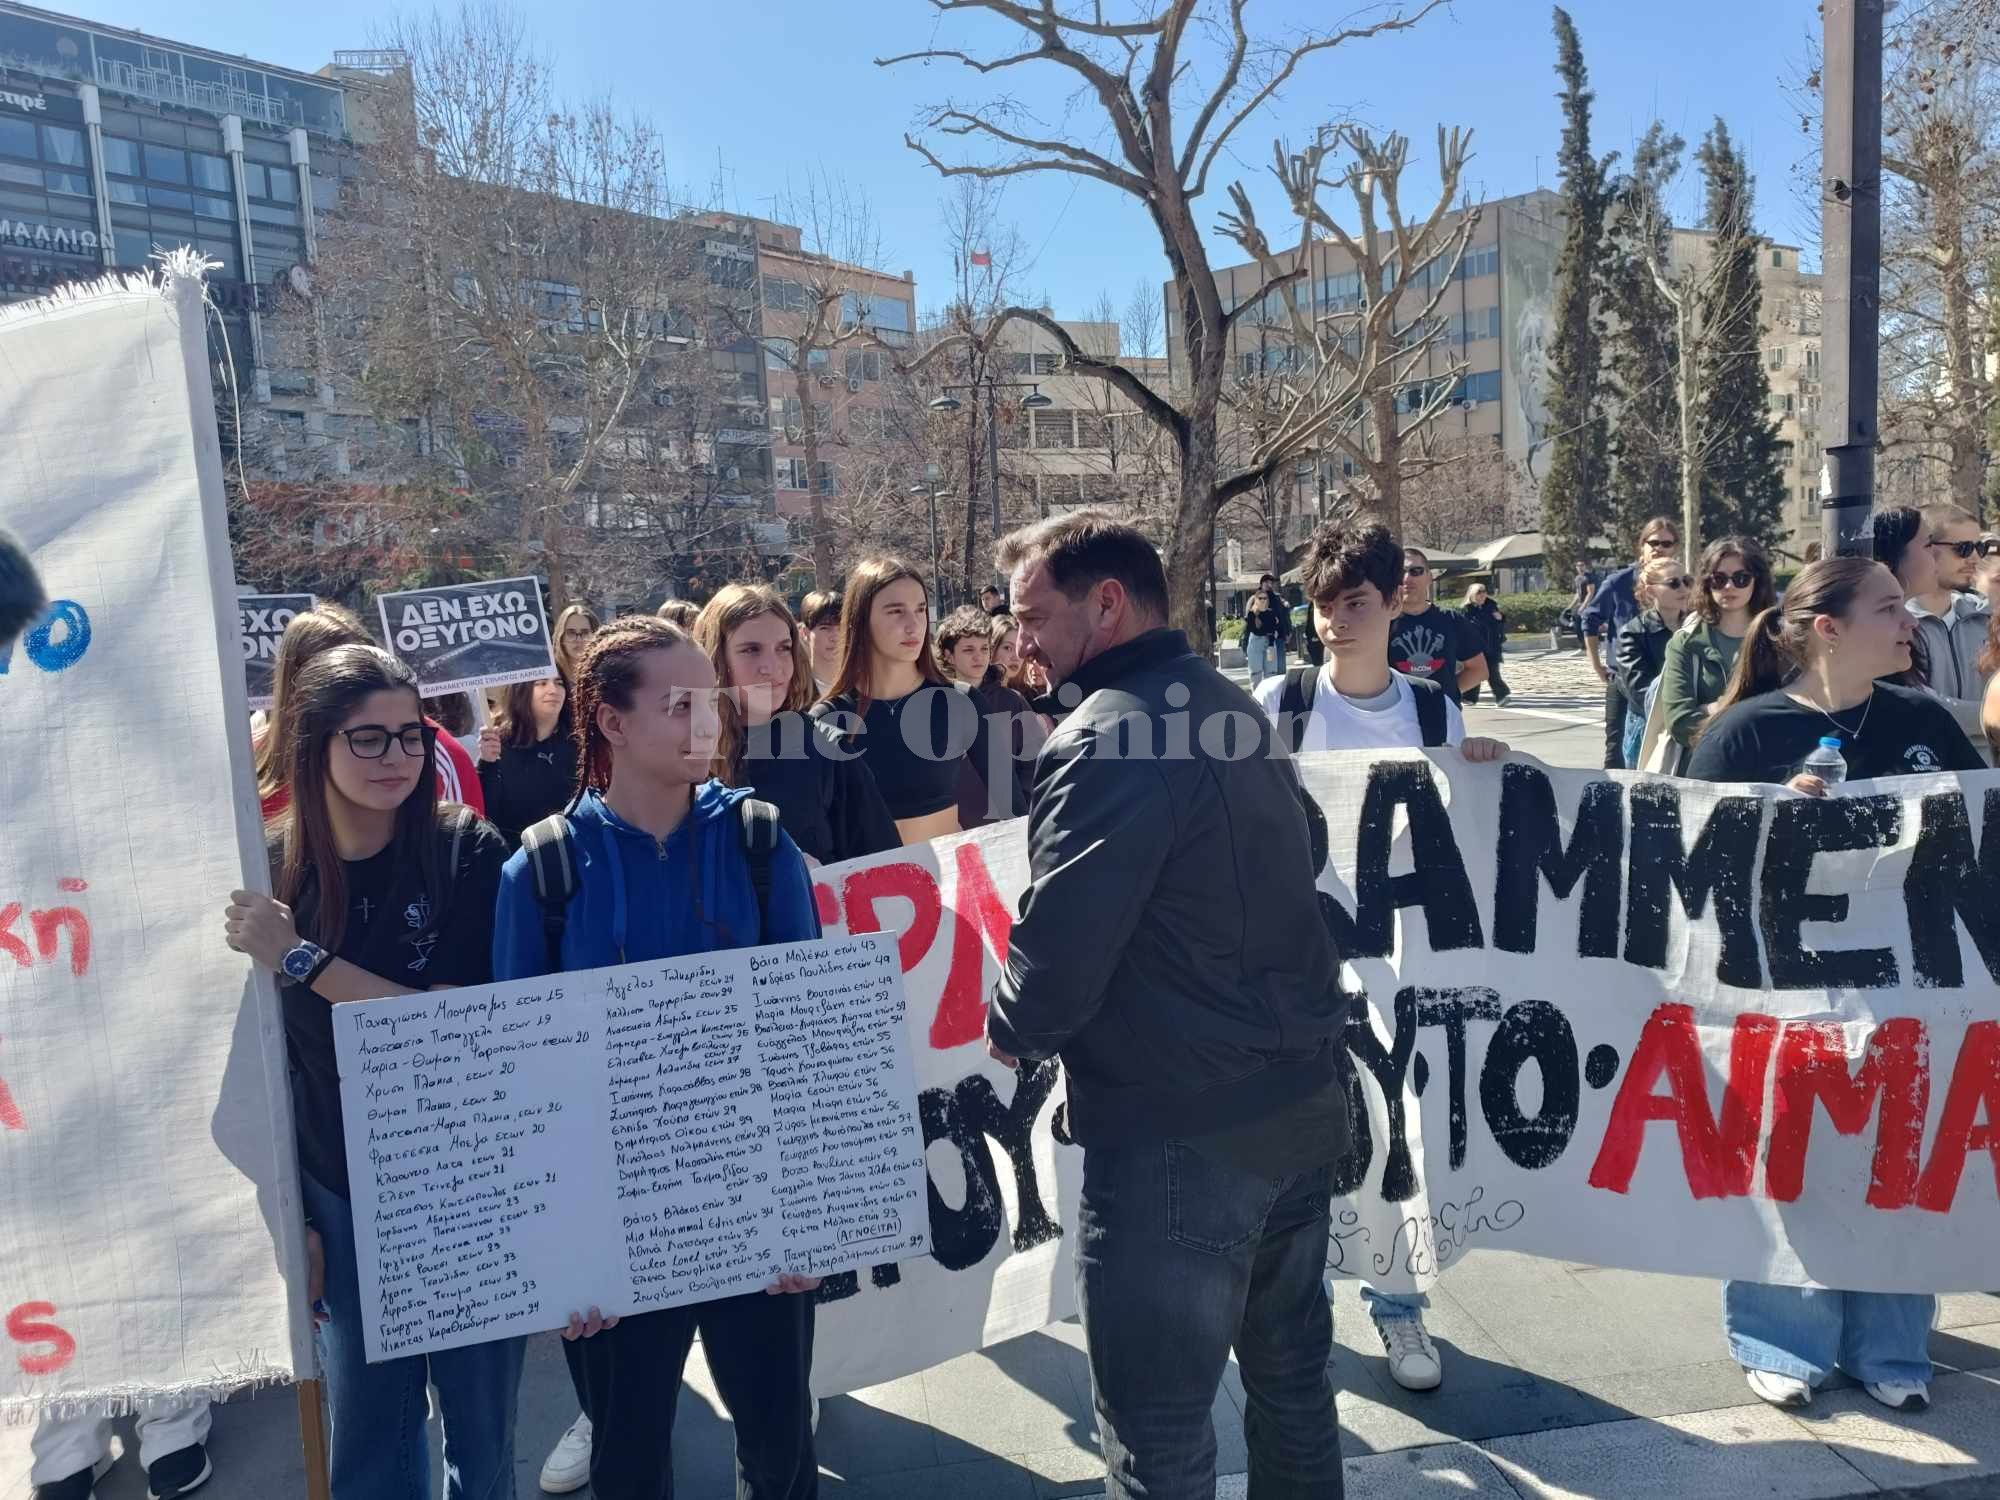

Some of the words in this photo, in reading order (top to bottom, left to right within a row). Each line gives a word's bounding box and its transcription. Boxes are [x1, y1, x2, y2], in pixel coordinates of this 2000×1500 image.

[401, 597, 462, 628] ΔΕΝ
[468, 591, 528, 618] ΕΧΩ
[396, 613, 540, 652] ΟΞΥΓΟΝΟ
[860, 939, 876, 951] 43
[874, 954, 890, 965] 49
[878, 975, 892, 985] 49
[545, 988, 563, 1001] 15
[536, 1013, 551, 1026] 19
[889, 1014, 902, 1024] 54
[575, 1031, 589, 1043] 20
[876, 1030, 891, 1041] 55
[500, 1061, 515, 1074] 20
[531, 1123, 545, 1134] 20
[727, 1193, 741, 1204] 34
[760, 1206, 773, 1217] 34
[743, 1226, 758, 1238] 35
[732, 1241, 747, 1252] 35
[754, 1248, 770, 1261] 35
[521, 1279, 536, 1294] 23
